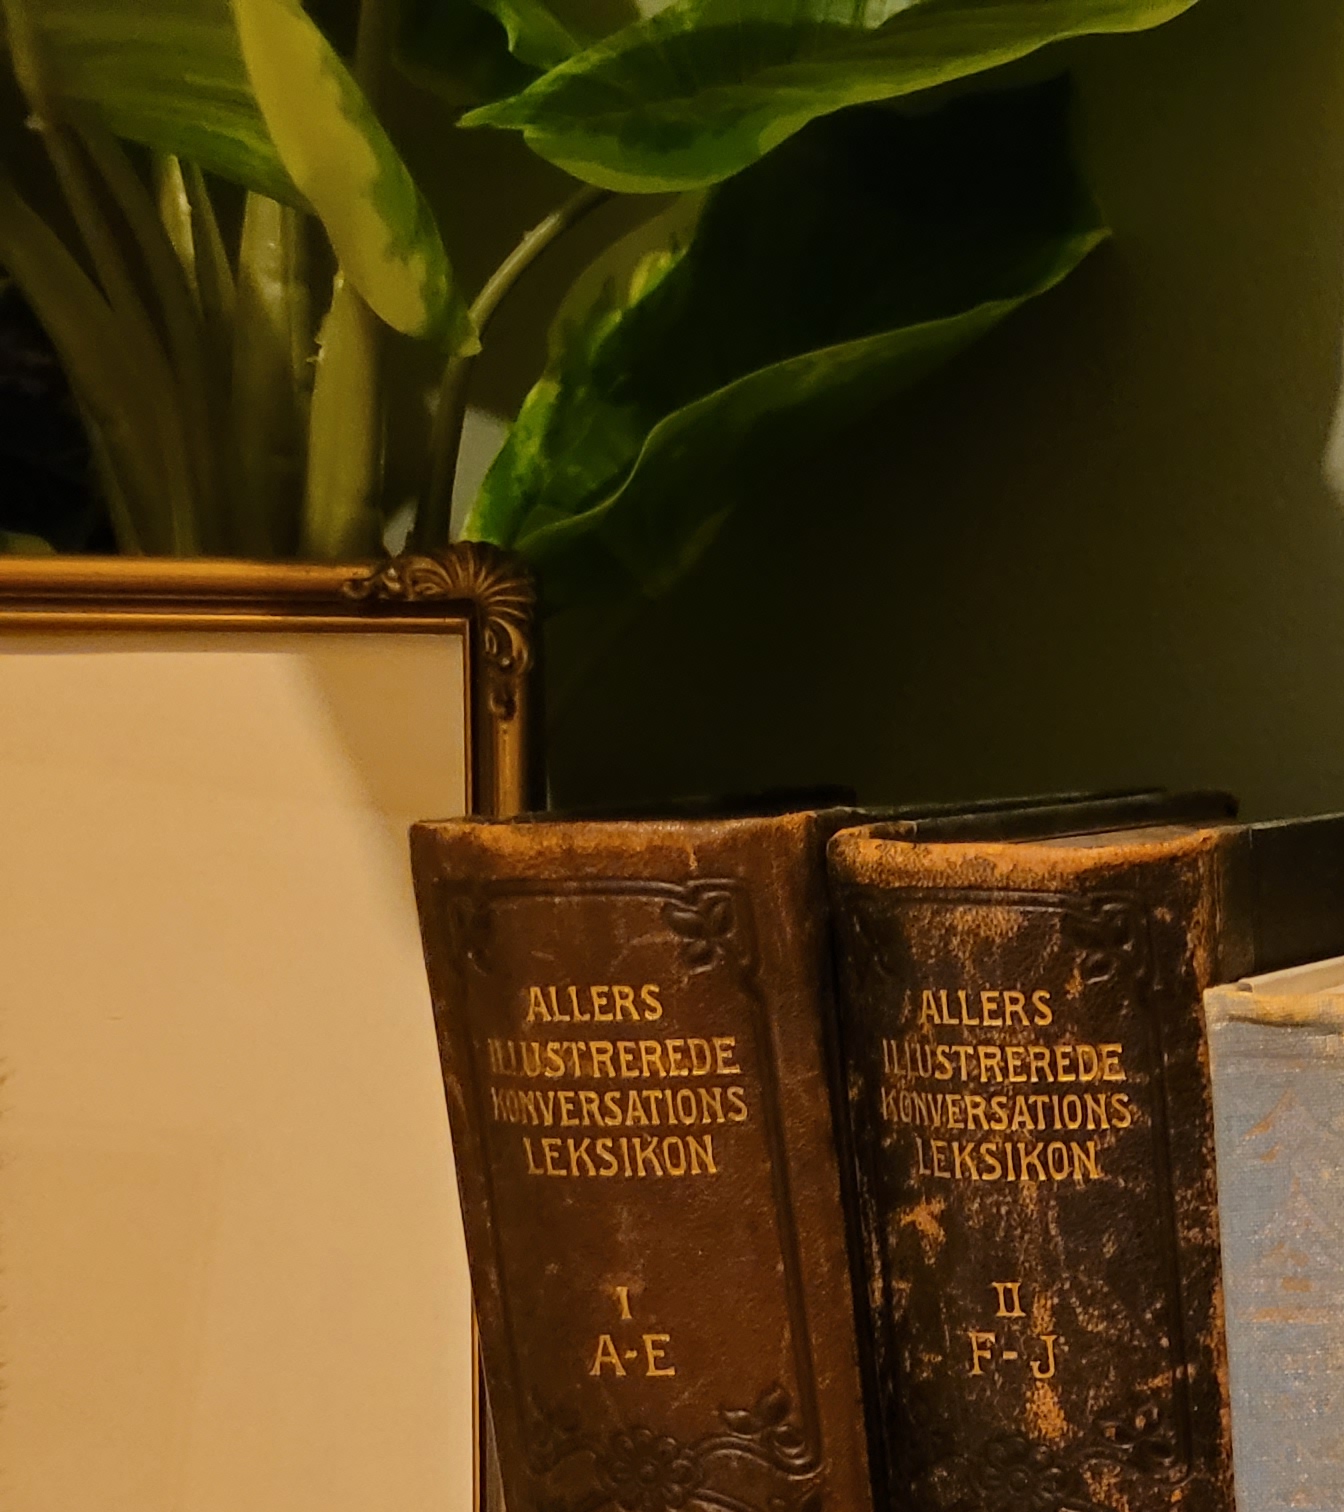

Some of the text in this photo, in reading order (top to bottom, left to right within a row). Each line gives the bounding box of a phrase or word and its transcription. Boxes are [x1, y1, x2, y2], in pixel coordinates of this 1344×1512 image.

[526, 983, 663, 1022] ALLERS
[920, 988, 1053, 1026] ALLERS
[487, 1036, 742, 1078] ILLUSTREREDE
[882, 1043, 1127, 1083] ILLUSTREREDE
[490, 1086, 748, 1127] KONVERSATIONS
[881, 1087, 1132, 1131] KONVERSATIONS
[523, 1134, 717, 1177] LEKSIKON
[915, 1136, 1104, 1182] LEKSIKON
[616, 1286, 633, 1320] I
[991, 1282, 1026, 1317] II
[588, 1334, 676, 1376] A-E
